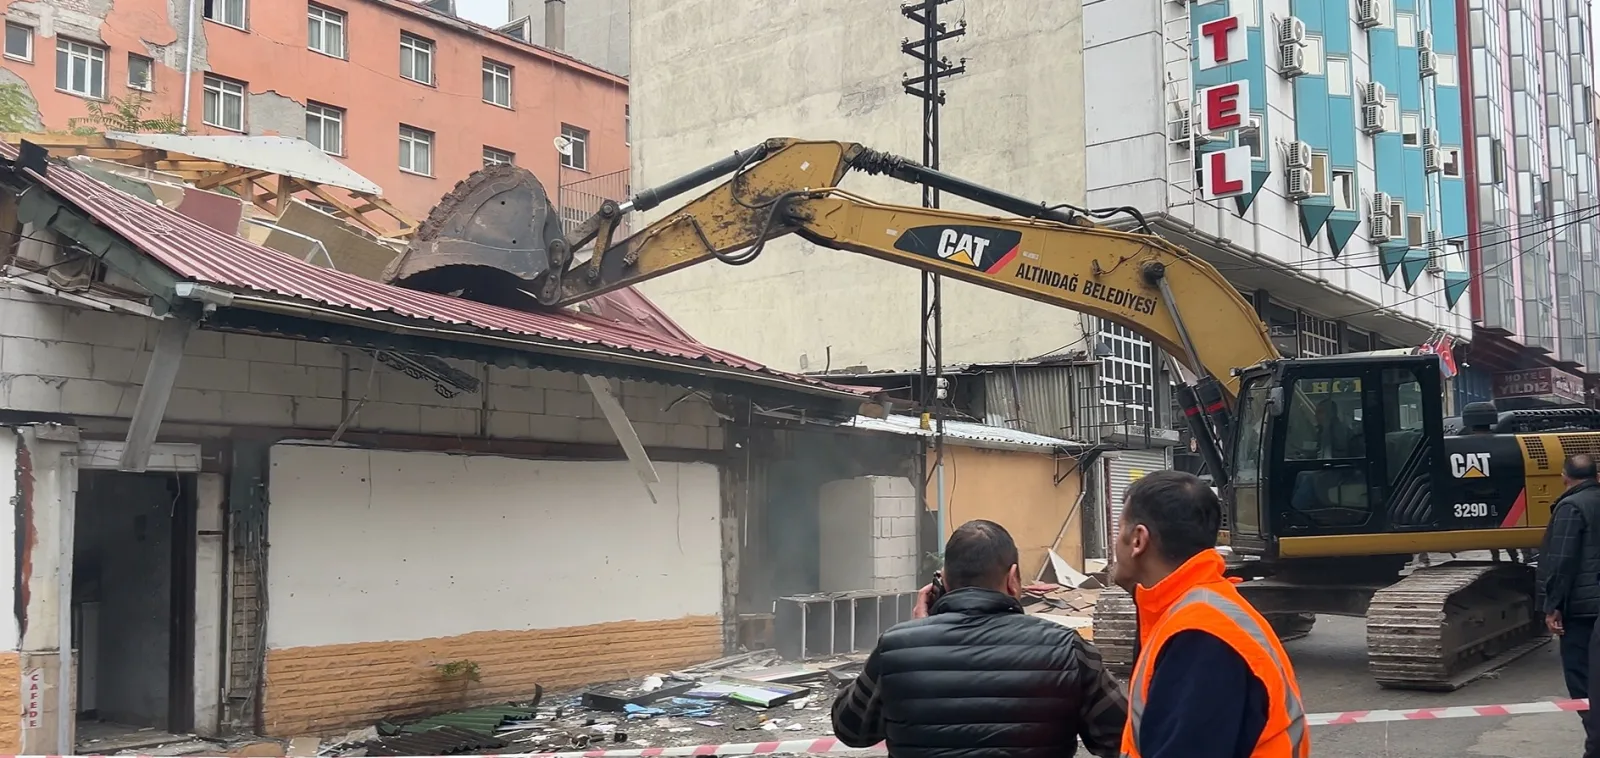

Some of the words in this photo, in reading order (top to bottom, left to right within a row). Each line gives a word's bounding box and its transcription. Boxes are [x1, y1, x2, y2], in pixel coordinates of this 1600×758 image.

[937, 228, 990, 267] CAT
[1015, 263, 1078, 293] ALTINDAĞ
[1082, 280, 1158, 316] BELEDİYESİ
[1504, 371, 1546, 382] HOTEL
[1450, 452, 1491, 478] CAT
[1453, 503, 1488, 517] 329D
